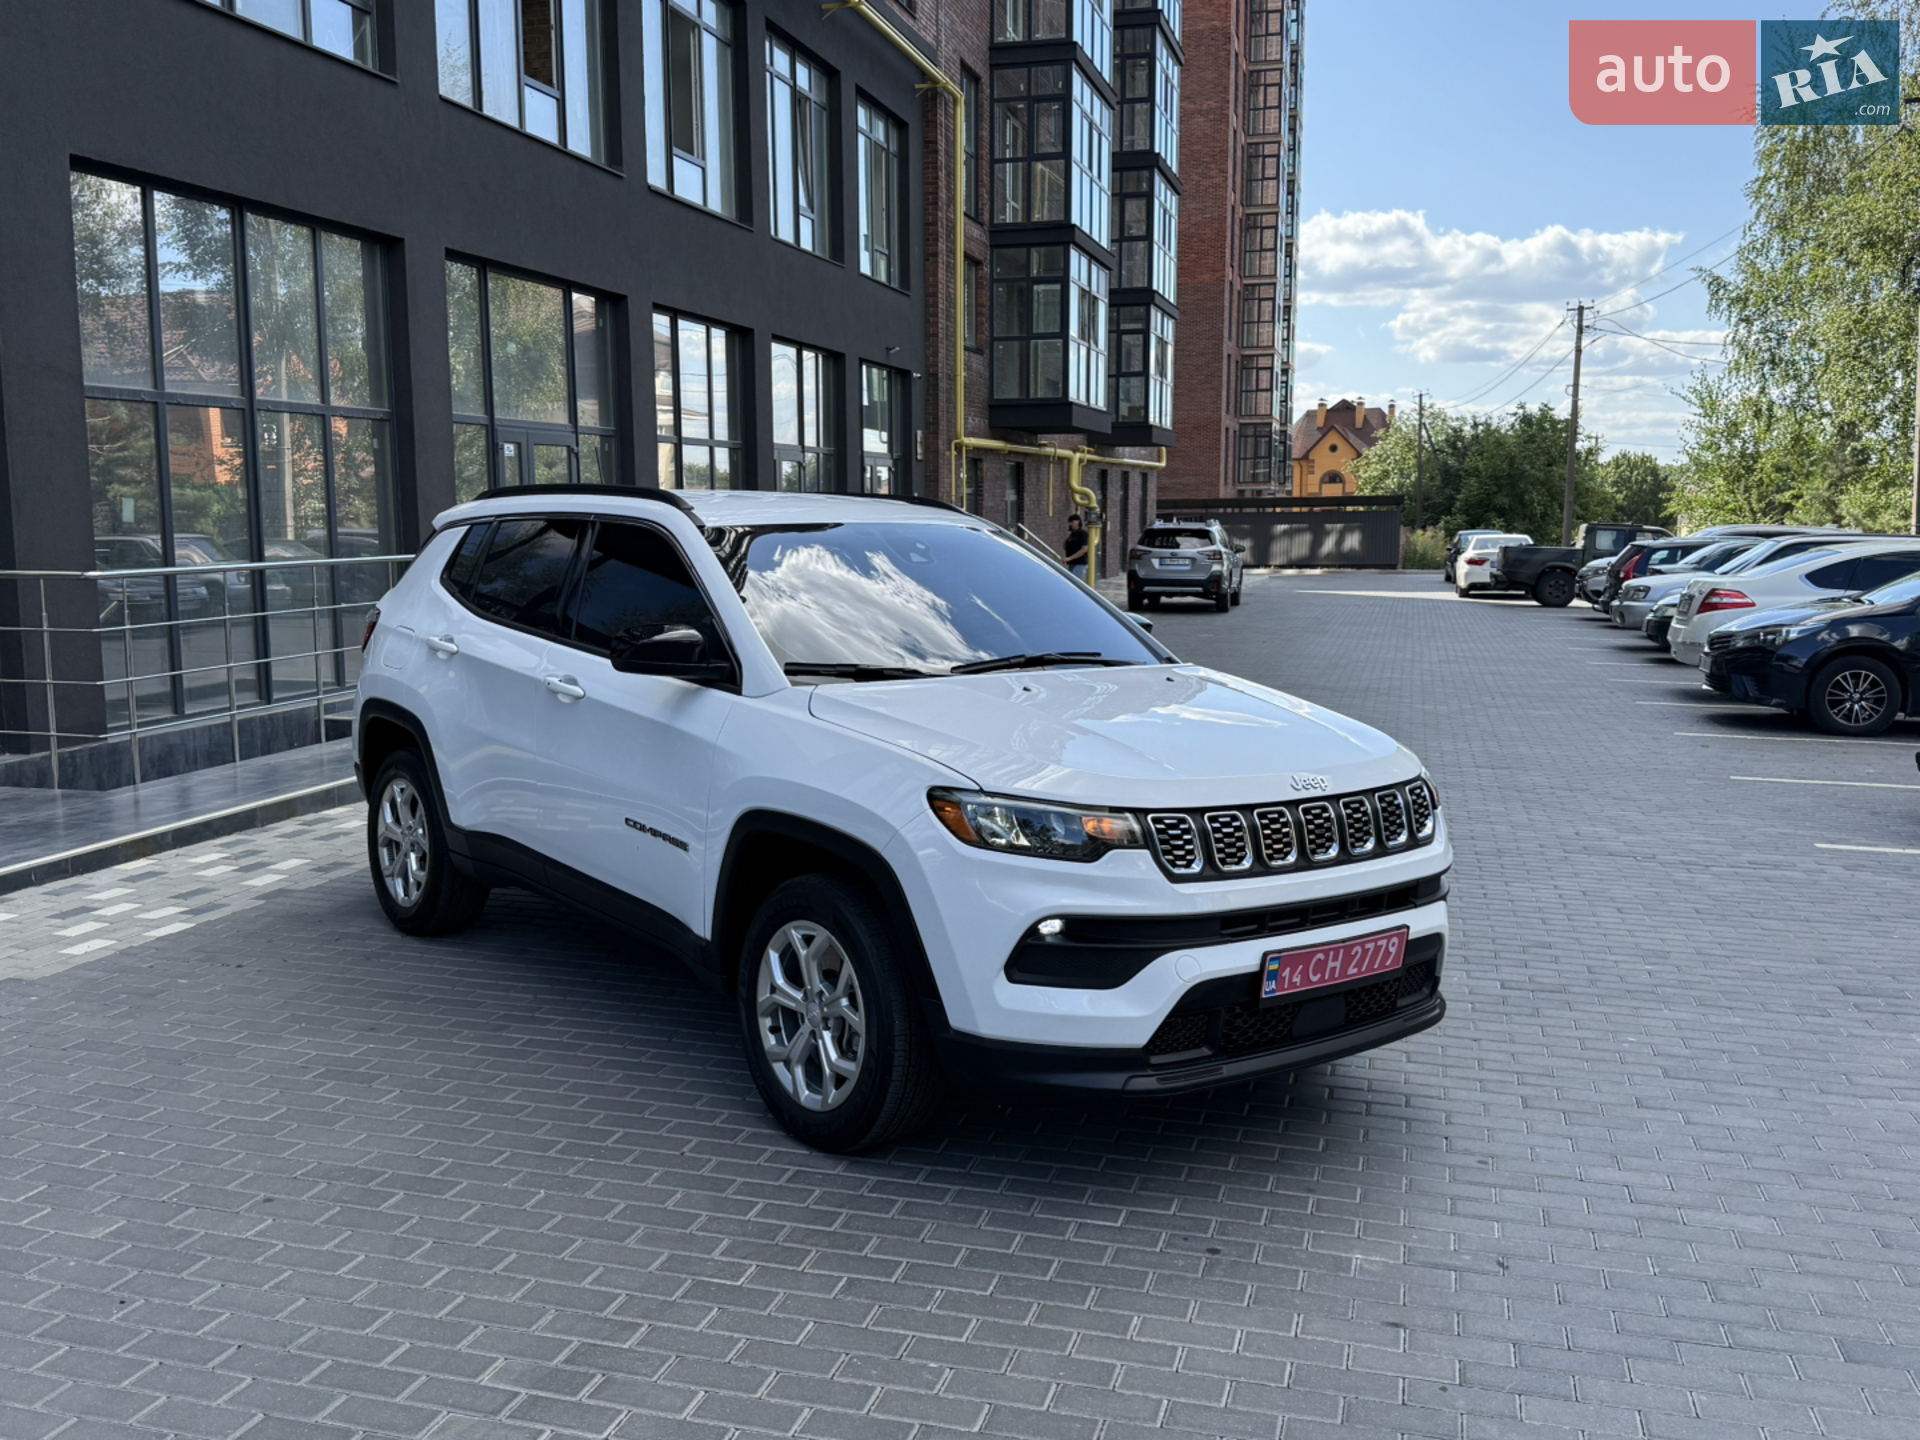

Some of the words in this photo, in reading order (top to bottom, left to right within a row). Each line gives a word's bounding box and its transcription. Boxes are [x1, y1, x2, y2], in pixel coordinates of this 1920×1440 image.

[1290, 775, 1328, 791] Jeep
[1282, 965, 1303, 989] 14
[1308, 949, 1344, 982] CH
[1347, 936, 1399, 976] 2779
[1265, 980, 1277, 992] UA
